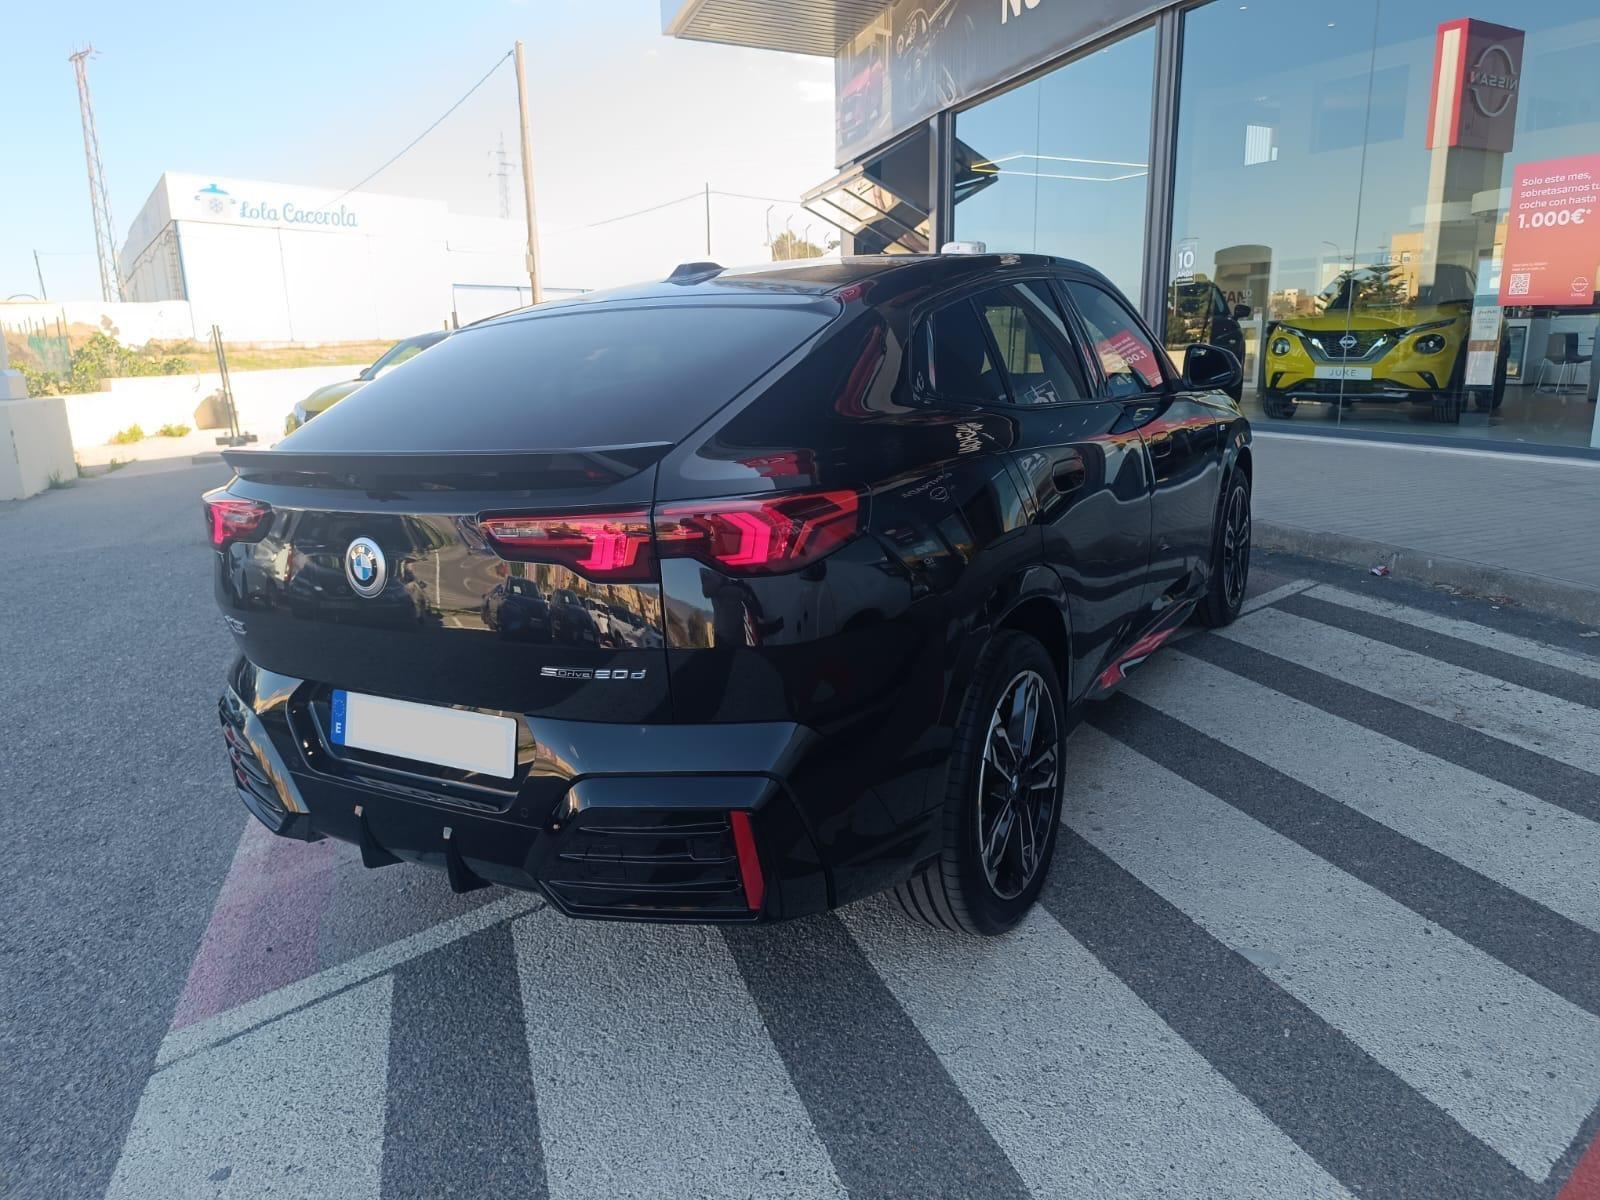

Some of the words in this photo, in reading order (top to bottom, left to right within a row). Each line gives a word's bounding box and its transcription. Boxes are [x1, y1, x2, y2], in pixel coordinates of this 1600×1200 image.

[1522, 177, 1543, 187] Solo
[1544, 175, 1566, 184] este
[1567, 172, 1592, 180] mes,
[1520, 184, 1590, 198] sobretasamos
[1519, 201, 1547, 209] coche
[1548, 198, 1567, 207] con
[1568, 194, 1597, 205] hasta
[239, 200, 281, 221] Lola
[283, 202, 359, 228] Cacerola
[1178, 250, 1195, 269] 10
[1328, 369, 1358, 377] JUKE
[335, 721, 342, 734] E
